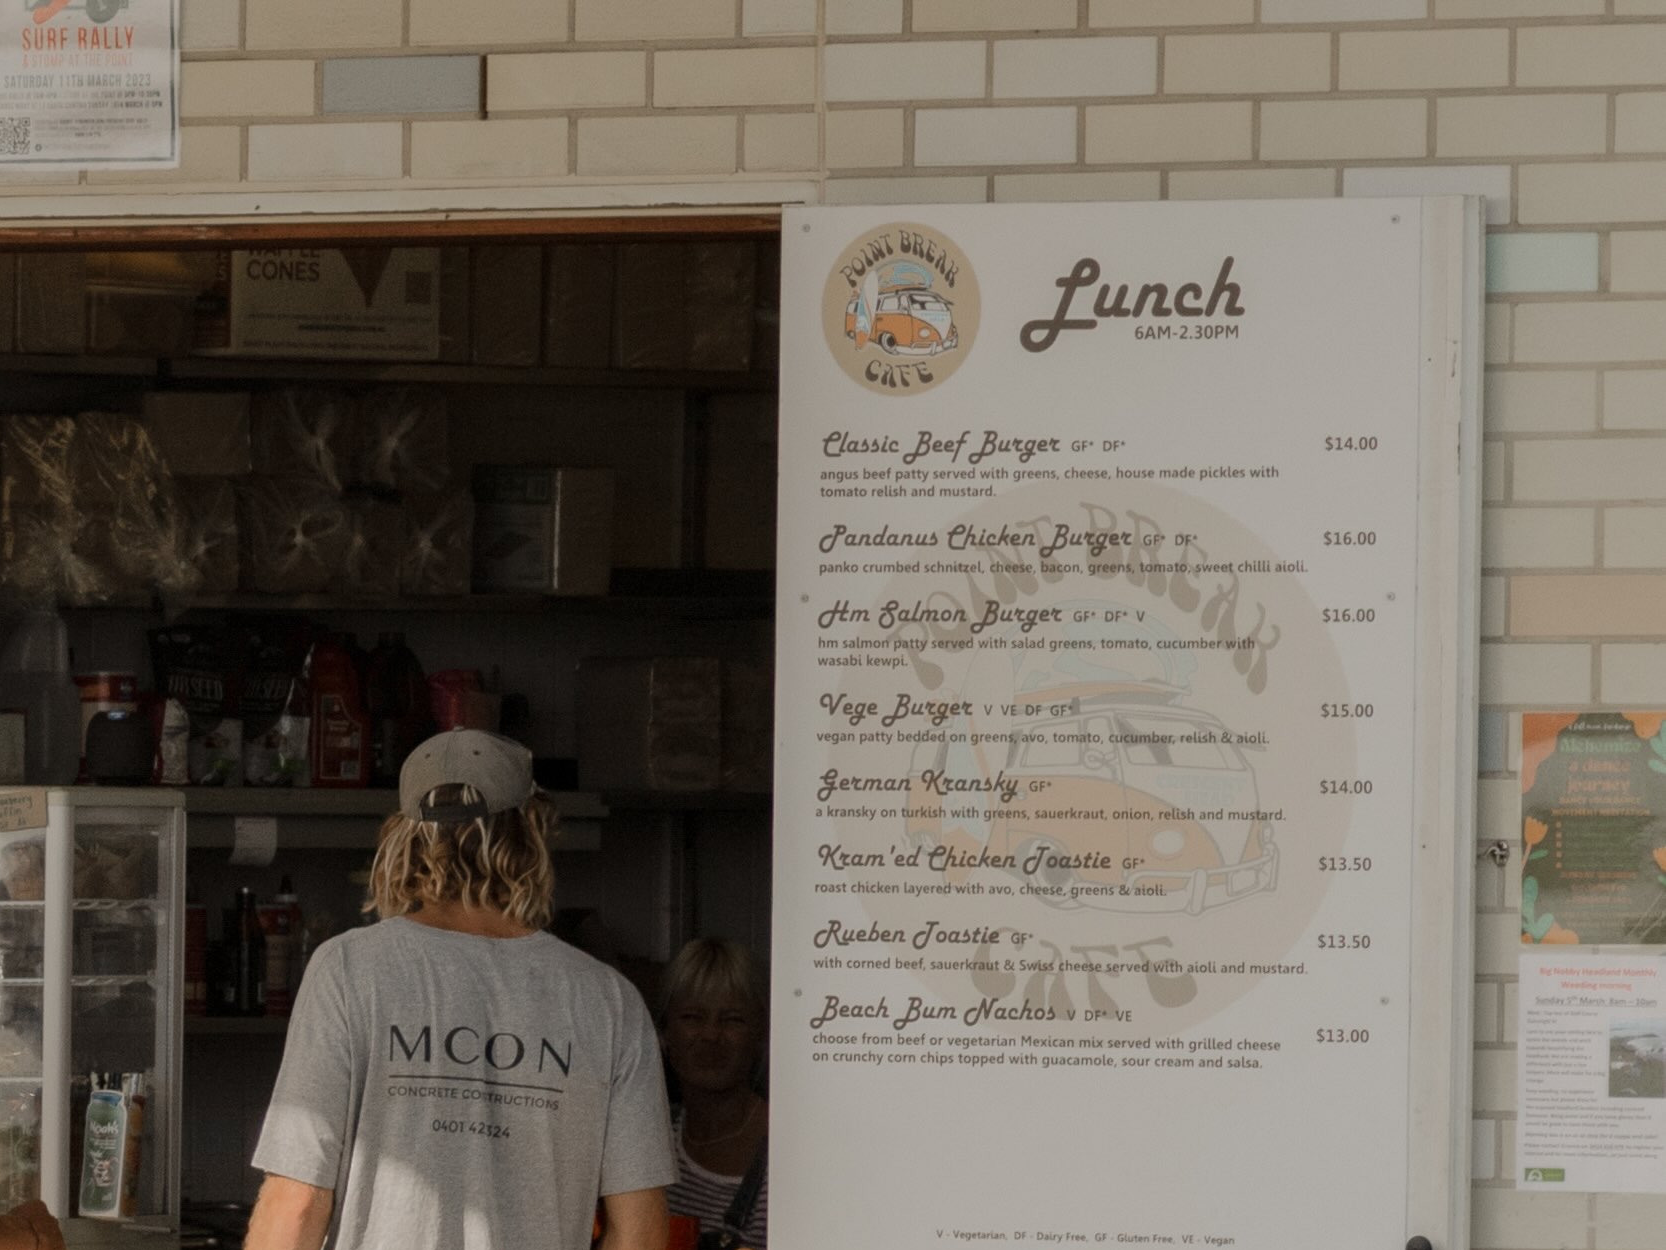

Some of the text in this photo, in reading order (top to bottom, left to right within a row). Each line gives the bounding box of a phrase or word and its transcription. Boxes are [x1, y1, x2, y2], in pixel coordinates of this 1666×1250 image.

[22, 26, 134, 50] SURF RALLY
[4, 73, 152, 89] SATURDAY 11TH MARCH 2023
[246, 259, 320, 282] CONES
[839, 230, 960, 288] POINT BREAK
[1020, 256, 1245, 353] Lunch
[1134, 324, 1239, 340] 6AM-2.30PM
[865, 359, 934, 388] CAFE
[822, 431, 1378, 465] Classic Beef Burger $14.00
[820, 485, 998, 498] tomato relish and mustard.
[819, 524, 1377, 559] Pandanus Chicken Burger $16.00
[818, 600, 1376, 634] Hm Salmon Burger $16.00
[820, 693, 1374, 727] Vege Burger $15.00
[817, 768, 911, 802] German
[921, 768, 1018, 803] Kransky
[1319, 779, 1373, 795] $14.00
[818, 844, 922, 870] Kram'ed
[927, 845, 1016, 872] Chicken
[1022, 846, 1110, 875] Toastie
[1318, 856, 1372, 872] $13.50
[814, 881, 1168, 900] roast chicken layered with avo, cheese, greens & aioli.
[814, 920, 906, 948] Rueben
[912, 921, 999, 949] Toastie
[1317, 934, 1371, 949] $13.50
[810, 996, 1370, 1043] Beach Bum Nachos $13.00
[389, 1025, 572, 1078] MCON
[388, 1086, 458, 1099] CONCRETE
[432, 1119, 464, 1133] 0401
